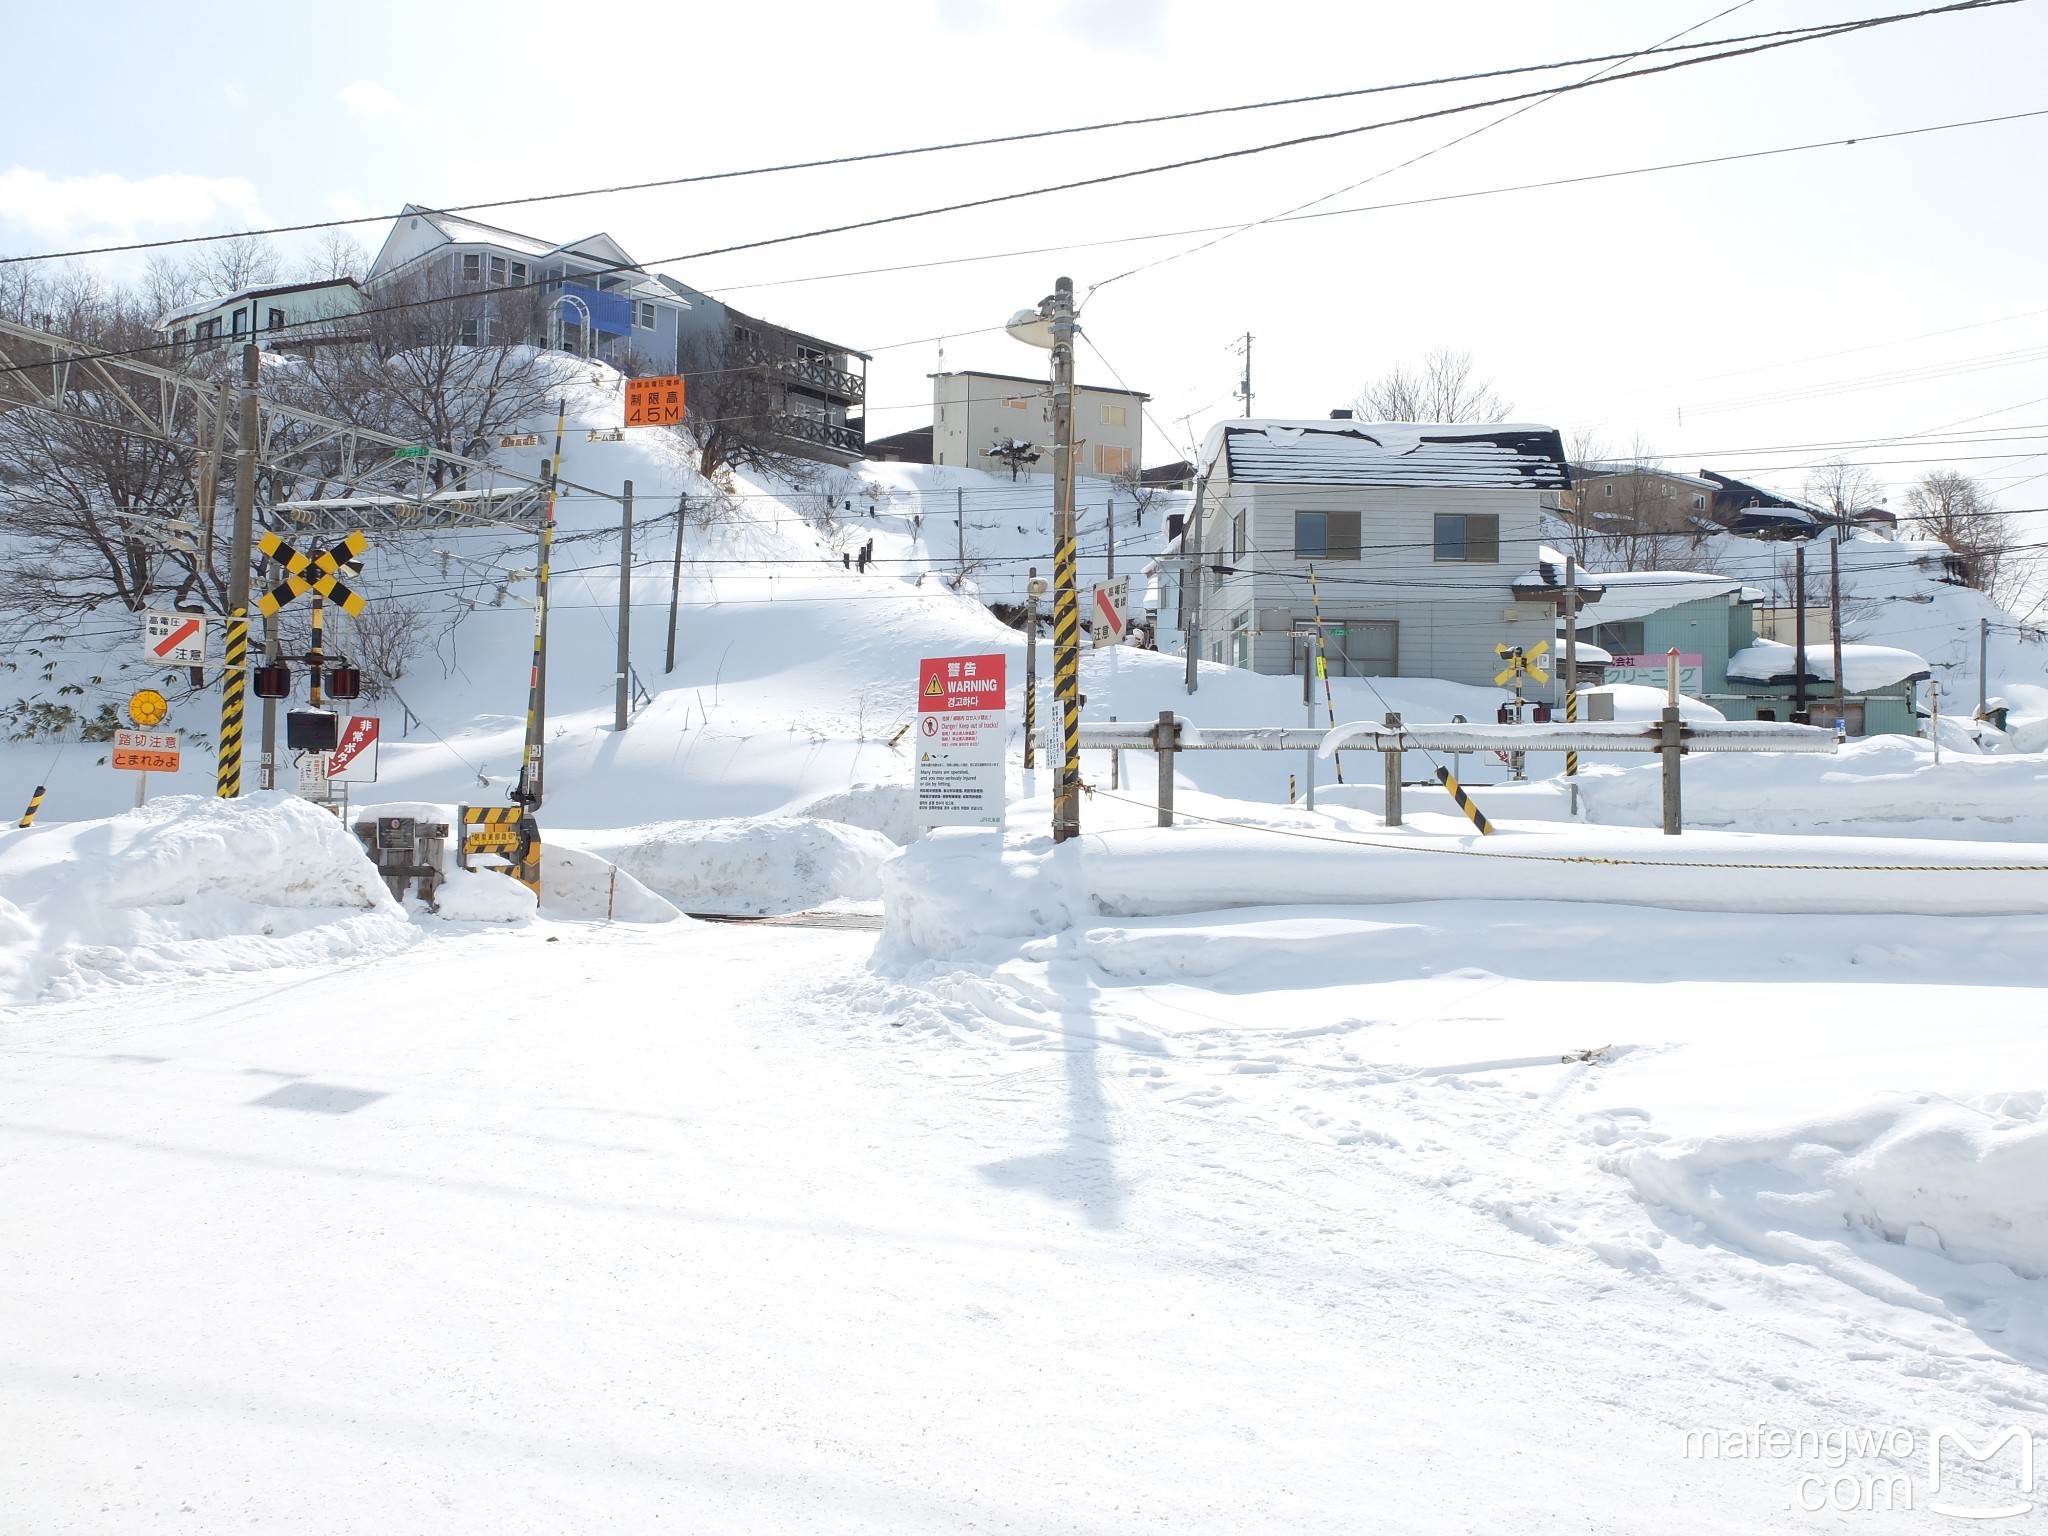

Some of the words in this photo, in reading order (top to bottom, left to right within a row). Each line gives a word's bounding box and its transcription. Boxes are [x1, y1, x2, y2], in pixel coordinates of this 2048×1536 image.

[631, 391, 678, 406] 制限高
[149, 616, 180, 626] 高電圧
[1094, 625, 1109, 641] 注意
[175, 648, 202, 660] 注意
[948, 679, 997, 693] WARNING
[948, 696, 978, 707] 경고하다
[118, 733, 176, 749] 踏切注意
[331, 720, 372, 772] 非常ボタン
[115, 753, 176, 767] とまれみよ
